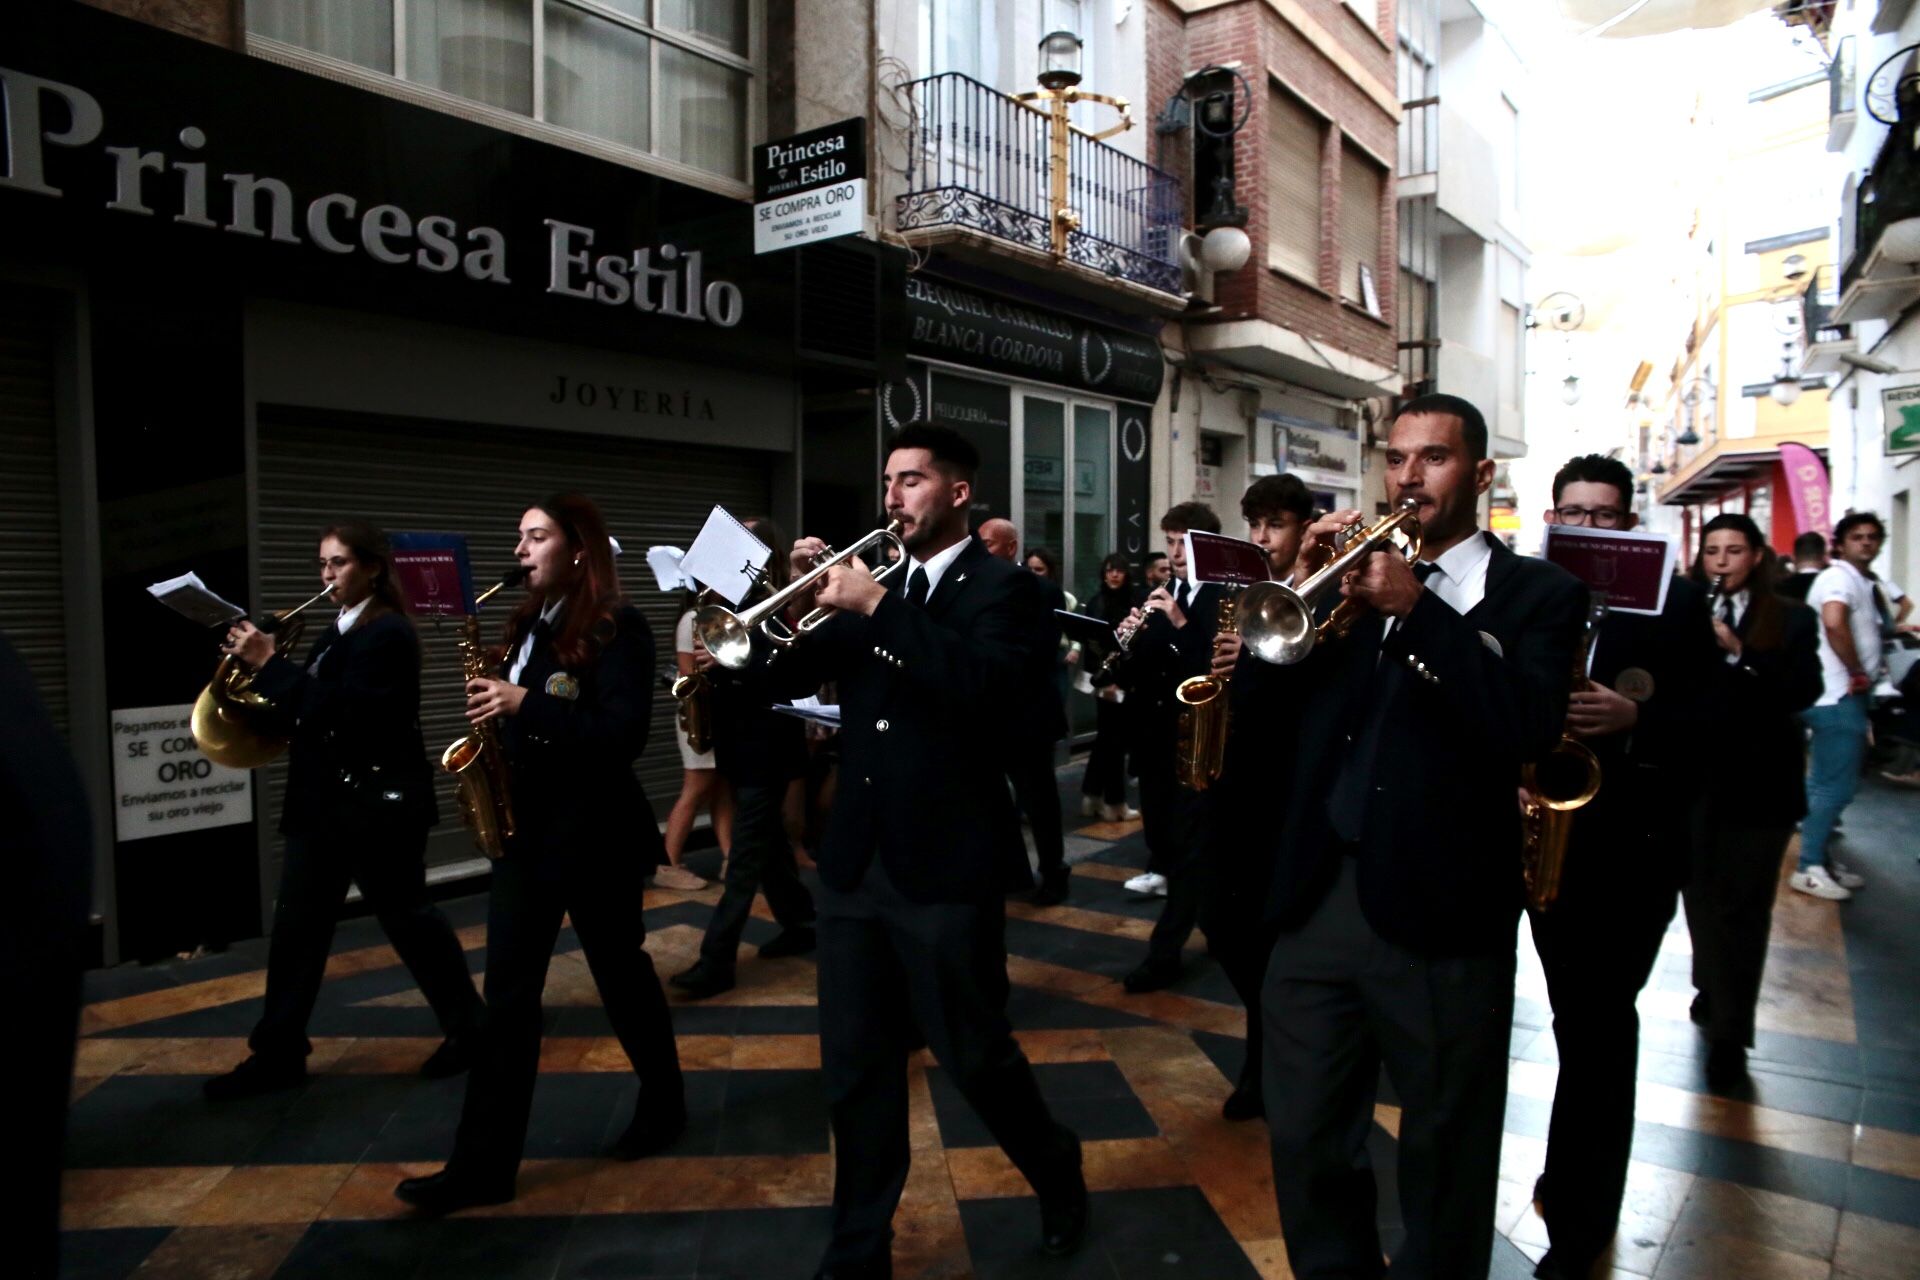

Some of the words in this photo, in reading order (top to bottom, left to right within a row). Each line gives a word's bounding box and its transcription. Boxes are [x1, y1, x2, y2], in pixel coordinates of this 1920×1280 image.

[767, 135, 845, 169] Princesa
[800, 158, 846, 185] Estilo
[0, 66, 512, 287] Princesa
[543, 218, 744, 329] Estilo
[759, 206, 772, 222] SE
[775, 195, 821, 217] COMPRA
[825, 185, 855, 205] ORO
[771, 218, 803, 232] ENVIAMOS
[912, 315, 985, 354] BLANCA
[990, 335, 1064, 371] CORDOVA
[550, 375, 714, 421] JOYERÍA
[115, 719, 176, 736] Pagamos
[128, 741, 149, 757] SE
[158, 758, 212, 783] ORO
[122, 789, 186, 807] Enviamos
[190, 790, 198, 798] a
[201, 780, 246, 796] reciclar
[148, 811, 164, 822] su
[167, 808, 190, 819] oro
[194, 802, 224, 816] viejo
